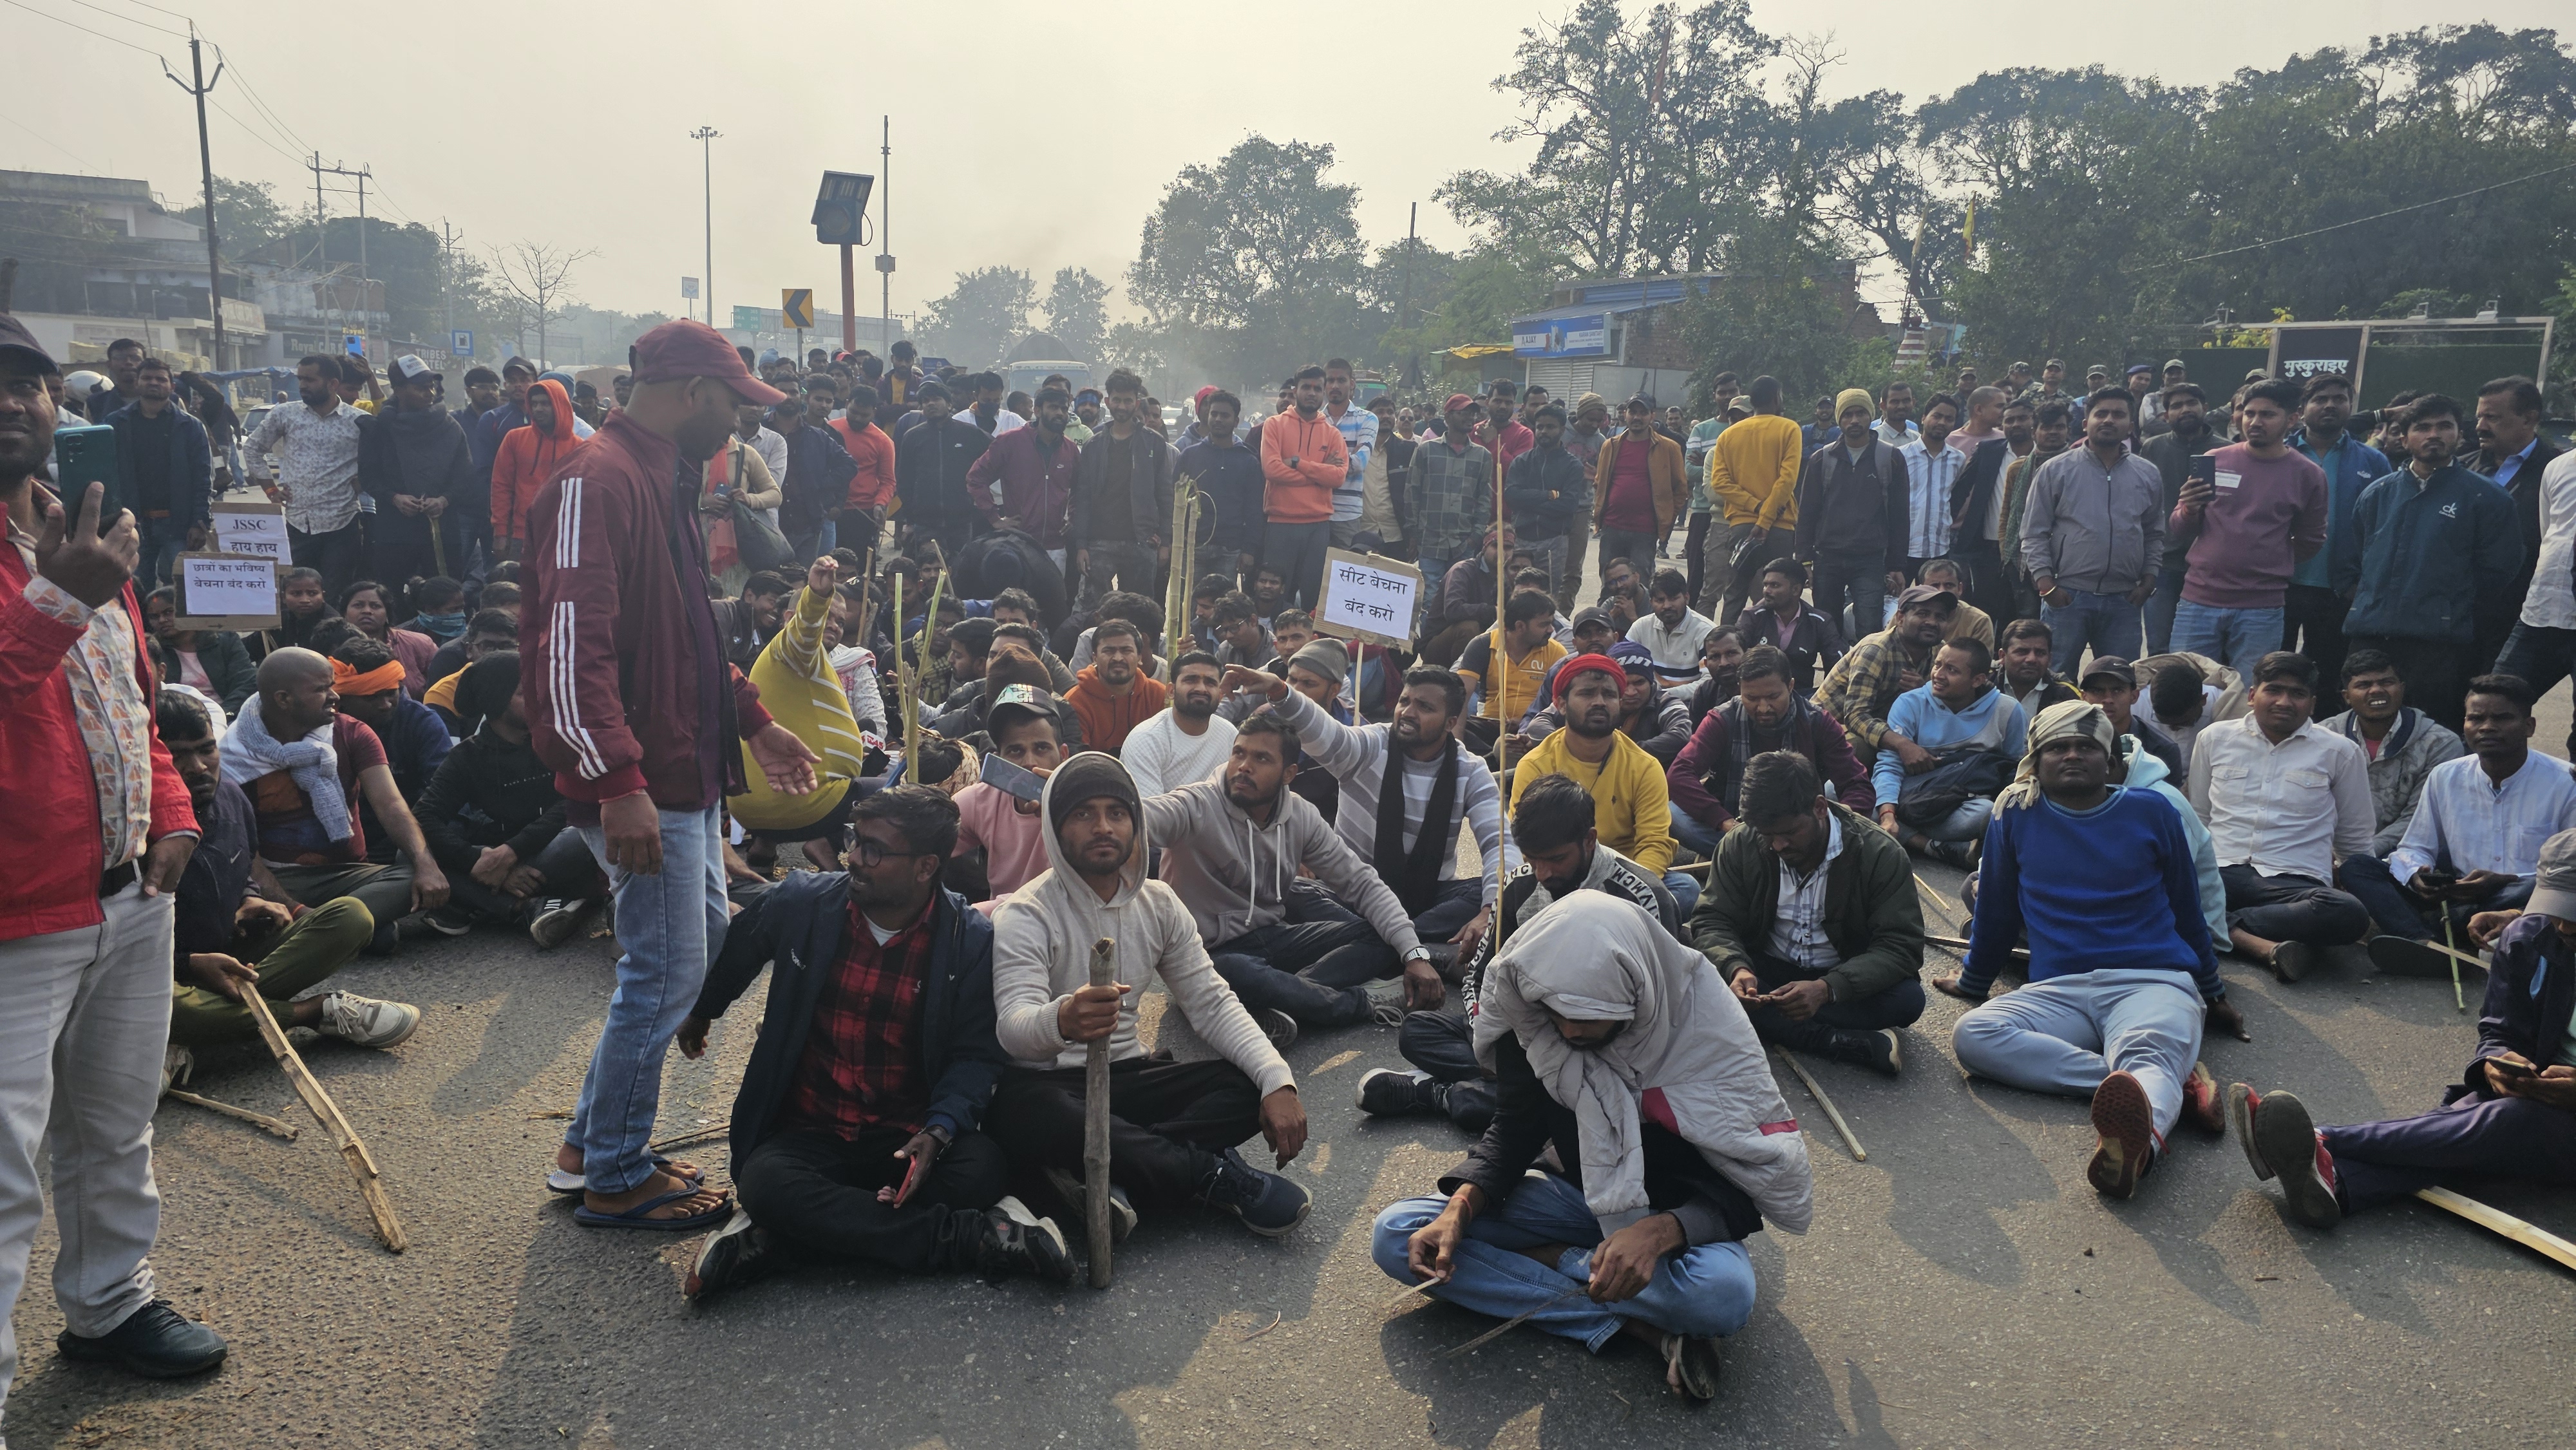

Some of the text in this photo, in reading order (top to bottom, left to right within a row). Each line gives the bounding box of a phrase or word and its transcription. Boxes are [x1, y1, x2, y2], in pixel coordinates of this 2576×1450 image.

[290, 338, 316, 355] Royal
[415, 348, 447, 360] TRIBES
[2283, 359, 2349, 377] मुस्कुराइए
[232, 519, 267, 531] JSSC
[230, 541, 278, 554] हाय हाय
[193, 561, 265, 572] छात्रों का भविष्य
[194, 577, 267, 589] बेचना बंद करो
[1339, 567, 1408, 596] सीट बेचना
[1344, 598, 1395, 622] बंद करो
